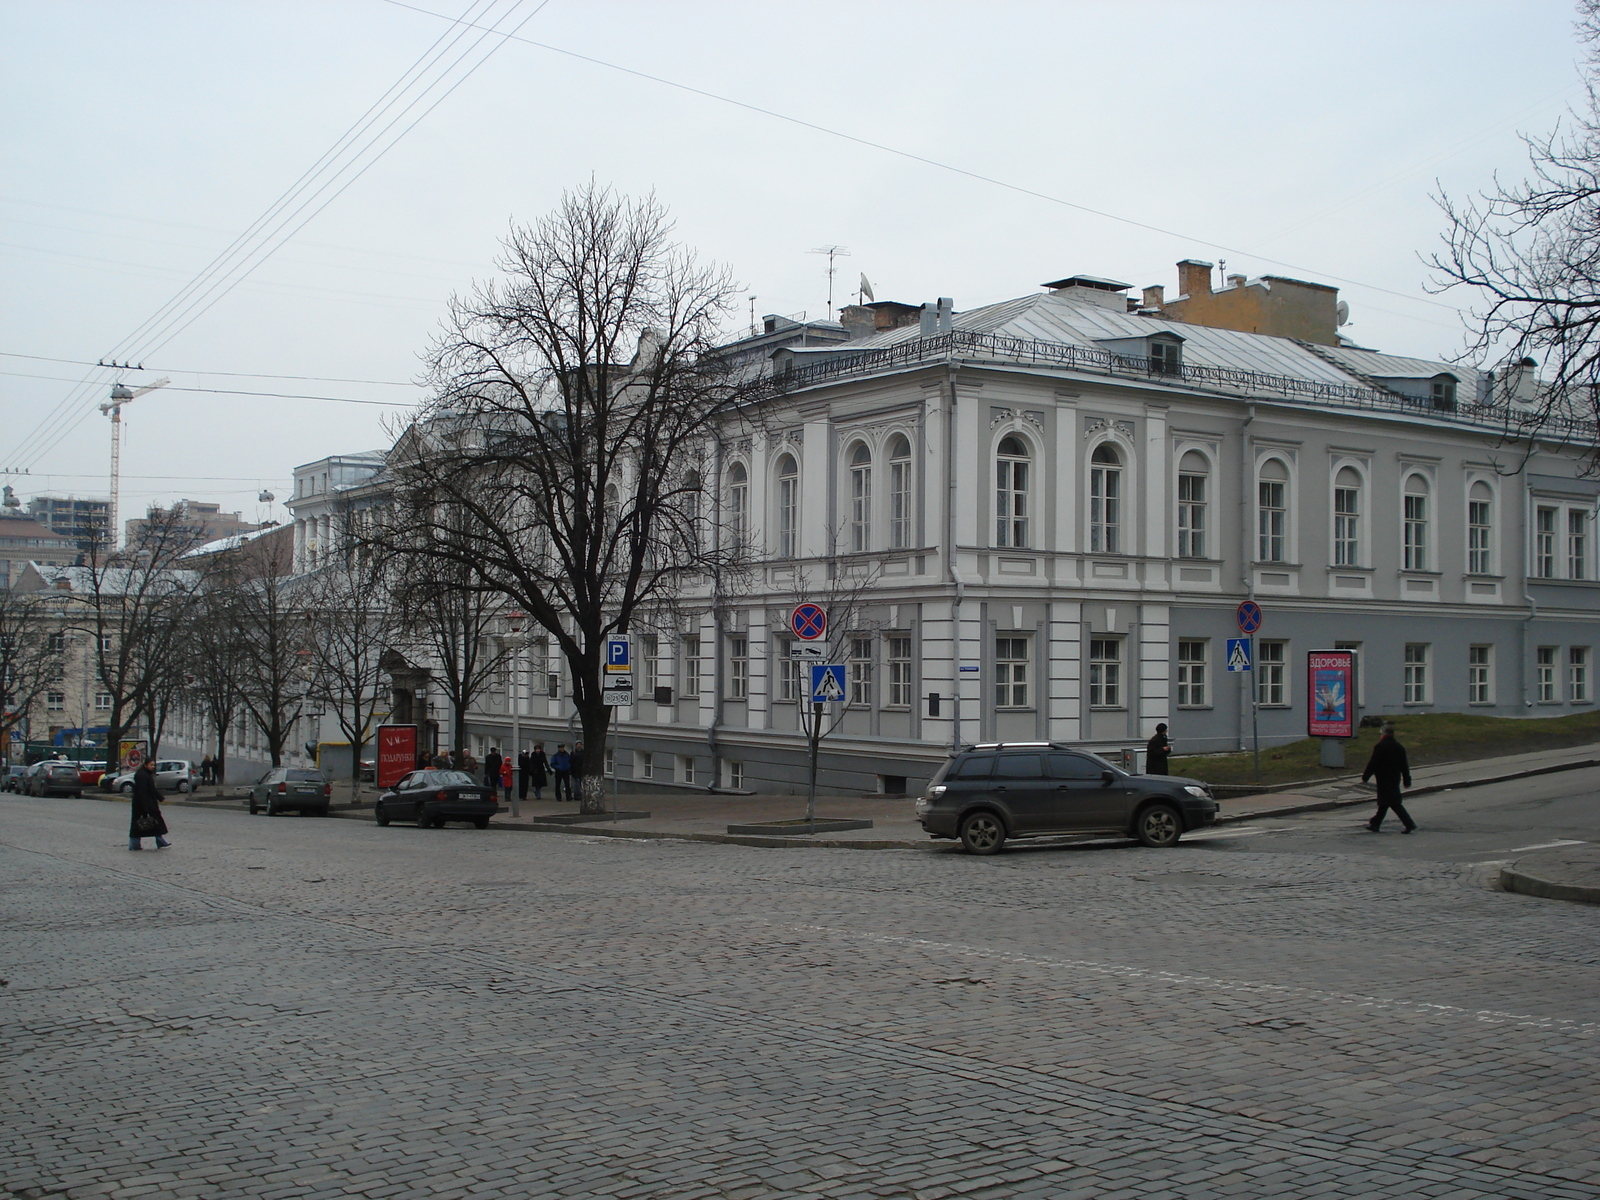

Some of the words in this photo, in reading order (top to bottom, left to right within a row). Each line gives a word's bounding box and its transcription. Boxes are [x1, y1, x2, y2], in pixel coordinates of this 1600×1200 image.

[612, 644, 624, 662] P
[1309, 657, 1351, 669] ЗДОРОВЬЕ
[620, 694, 629, 702] 50
[380, 753, 415, 763] ПОДАРУНКИ
